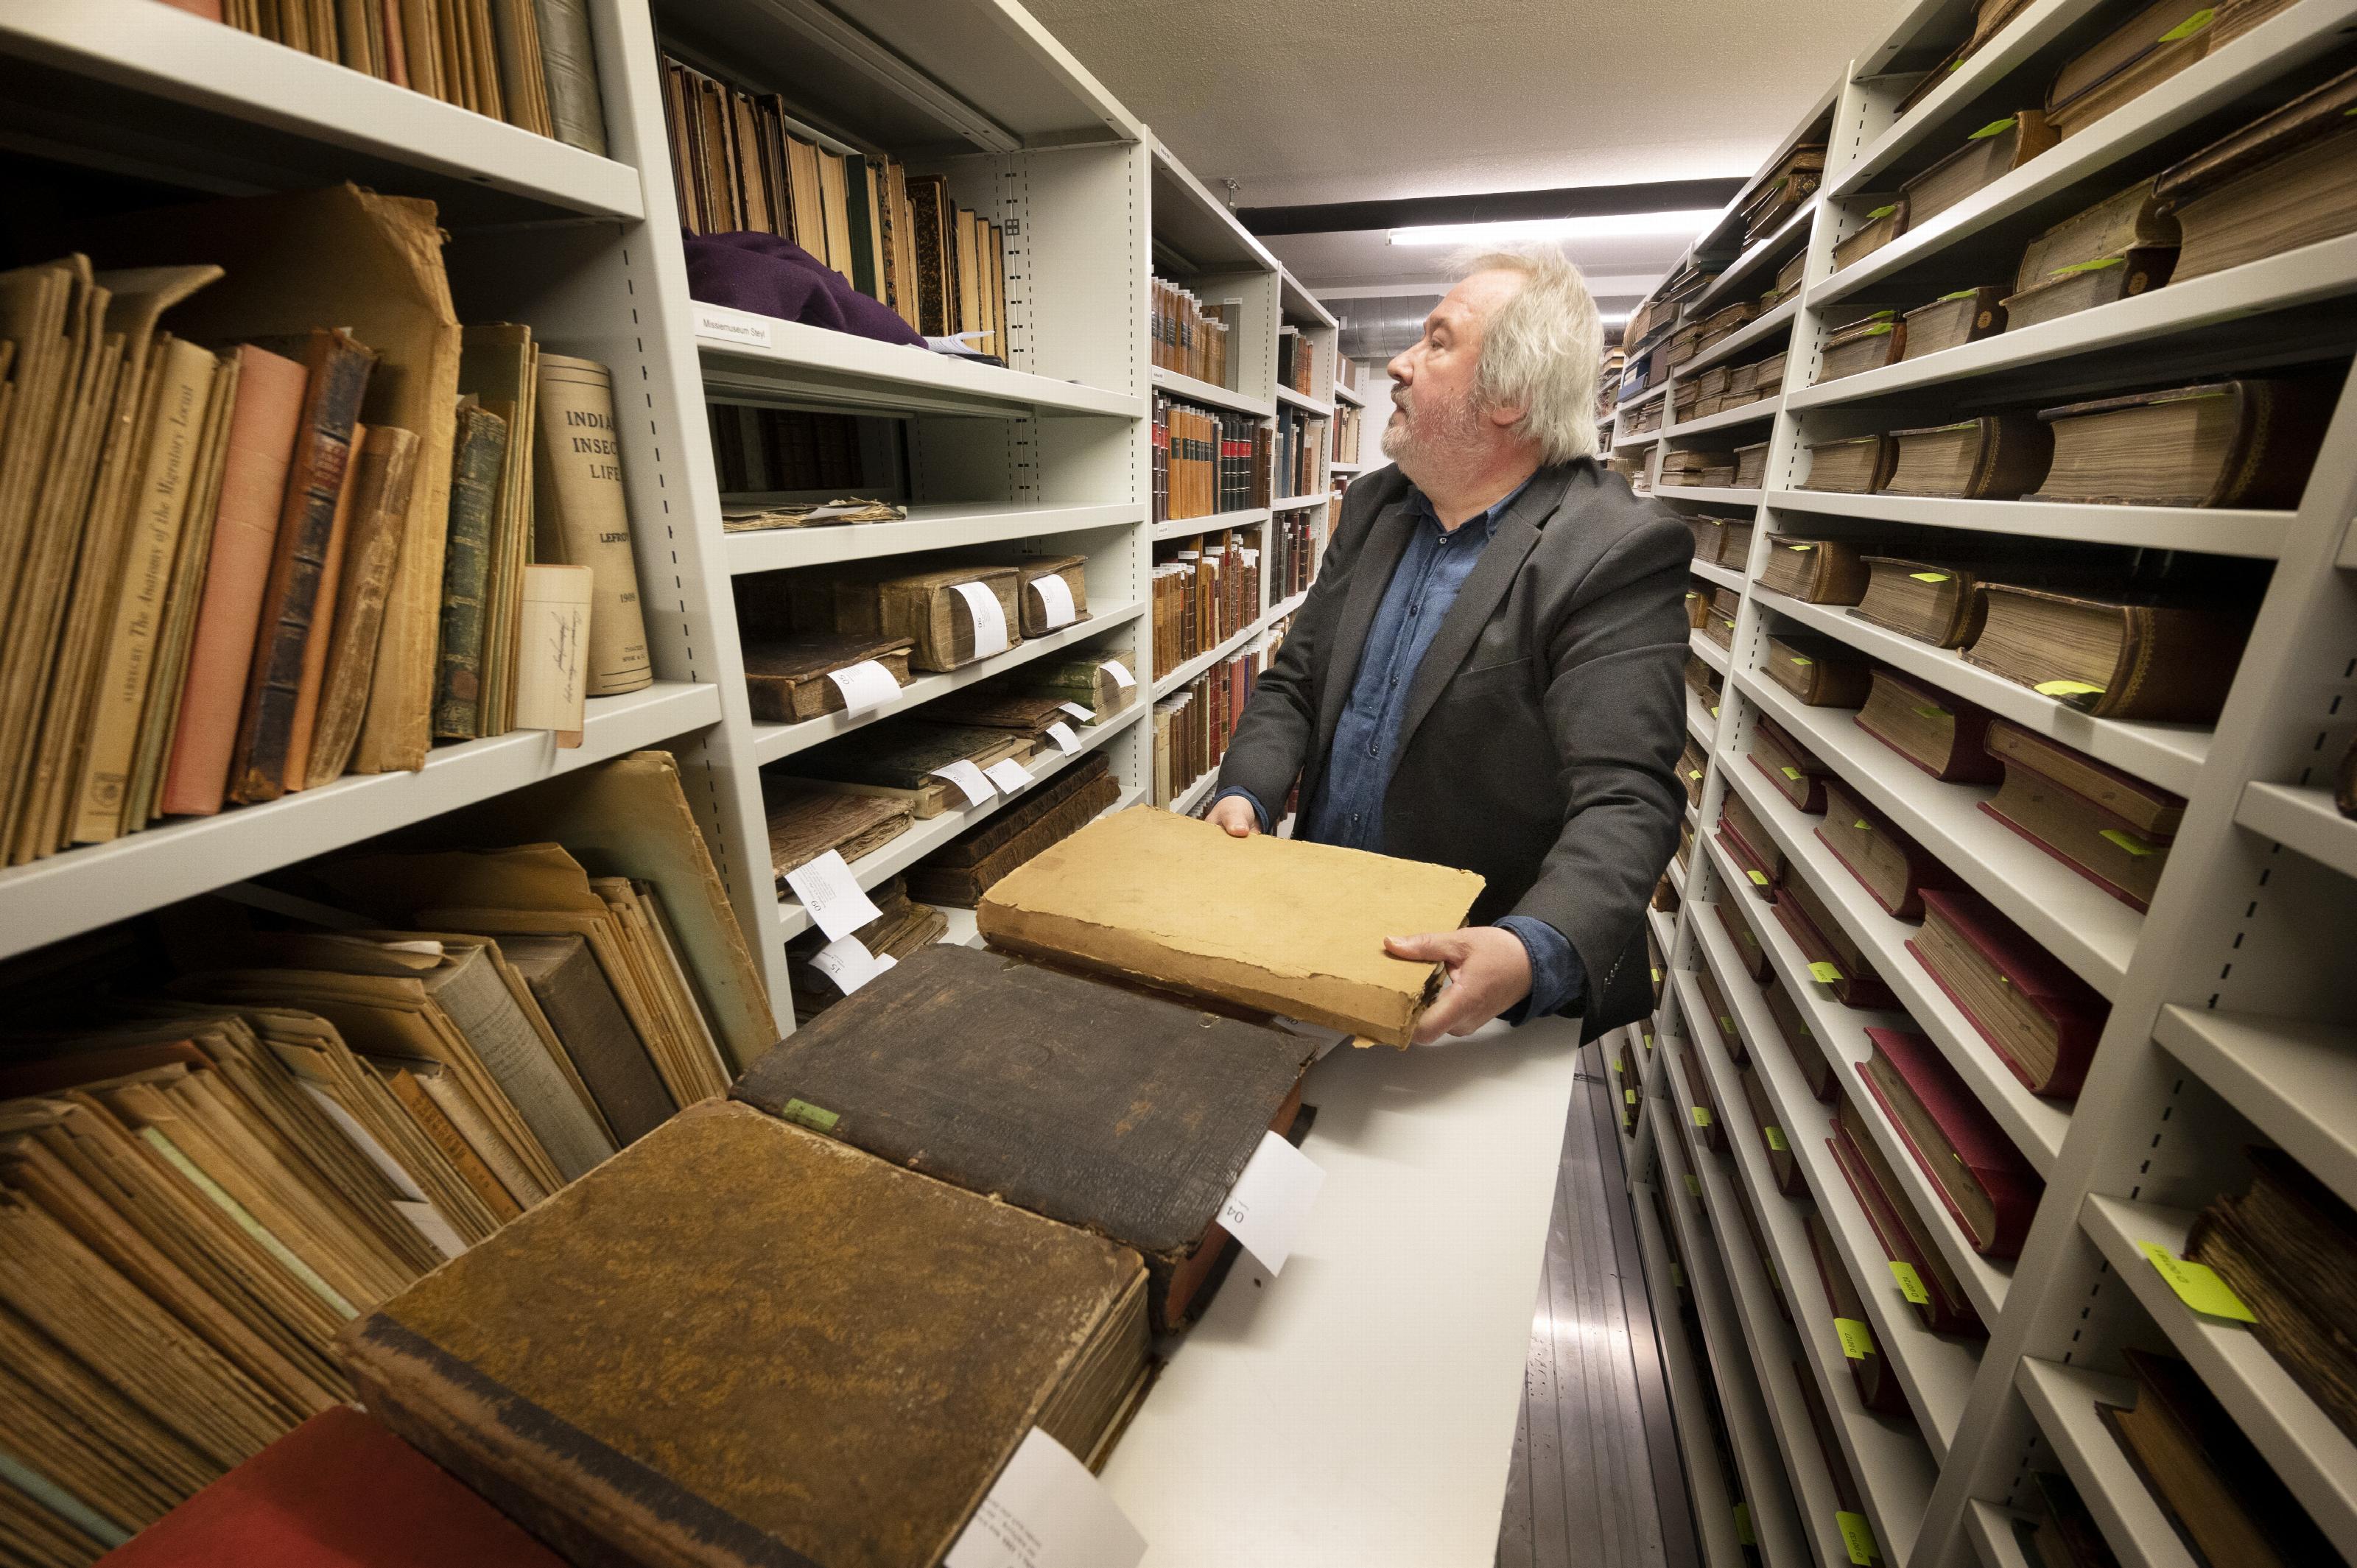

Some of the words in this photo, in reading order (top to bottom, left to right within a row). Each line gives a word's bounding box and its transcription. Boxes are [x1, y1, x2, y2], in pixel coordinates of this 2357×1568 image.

[751, 327, 765, 340] Steyl
[566, 410, 615, 432] INDIA
[572, 437, 617, 455] INSEC
[156, 432, 186, 496] Migratory
[590, 464, 620, 482] LIFE
[154, 501, 171, 525] the
[149, 524, 170, 544] of
[128, 610, 150, 638] The
[1227, 1206, 1244, 1223] 04
